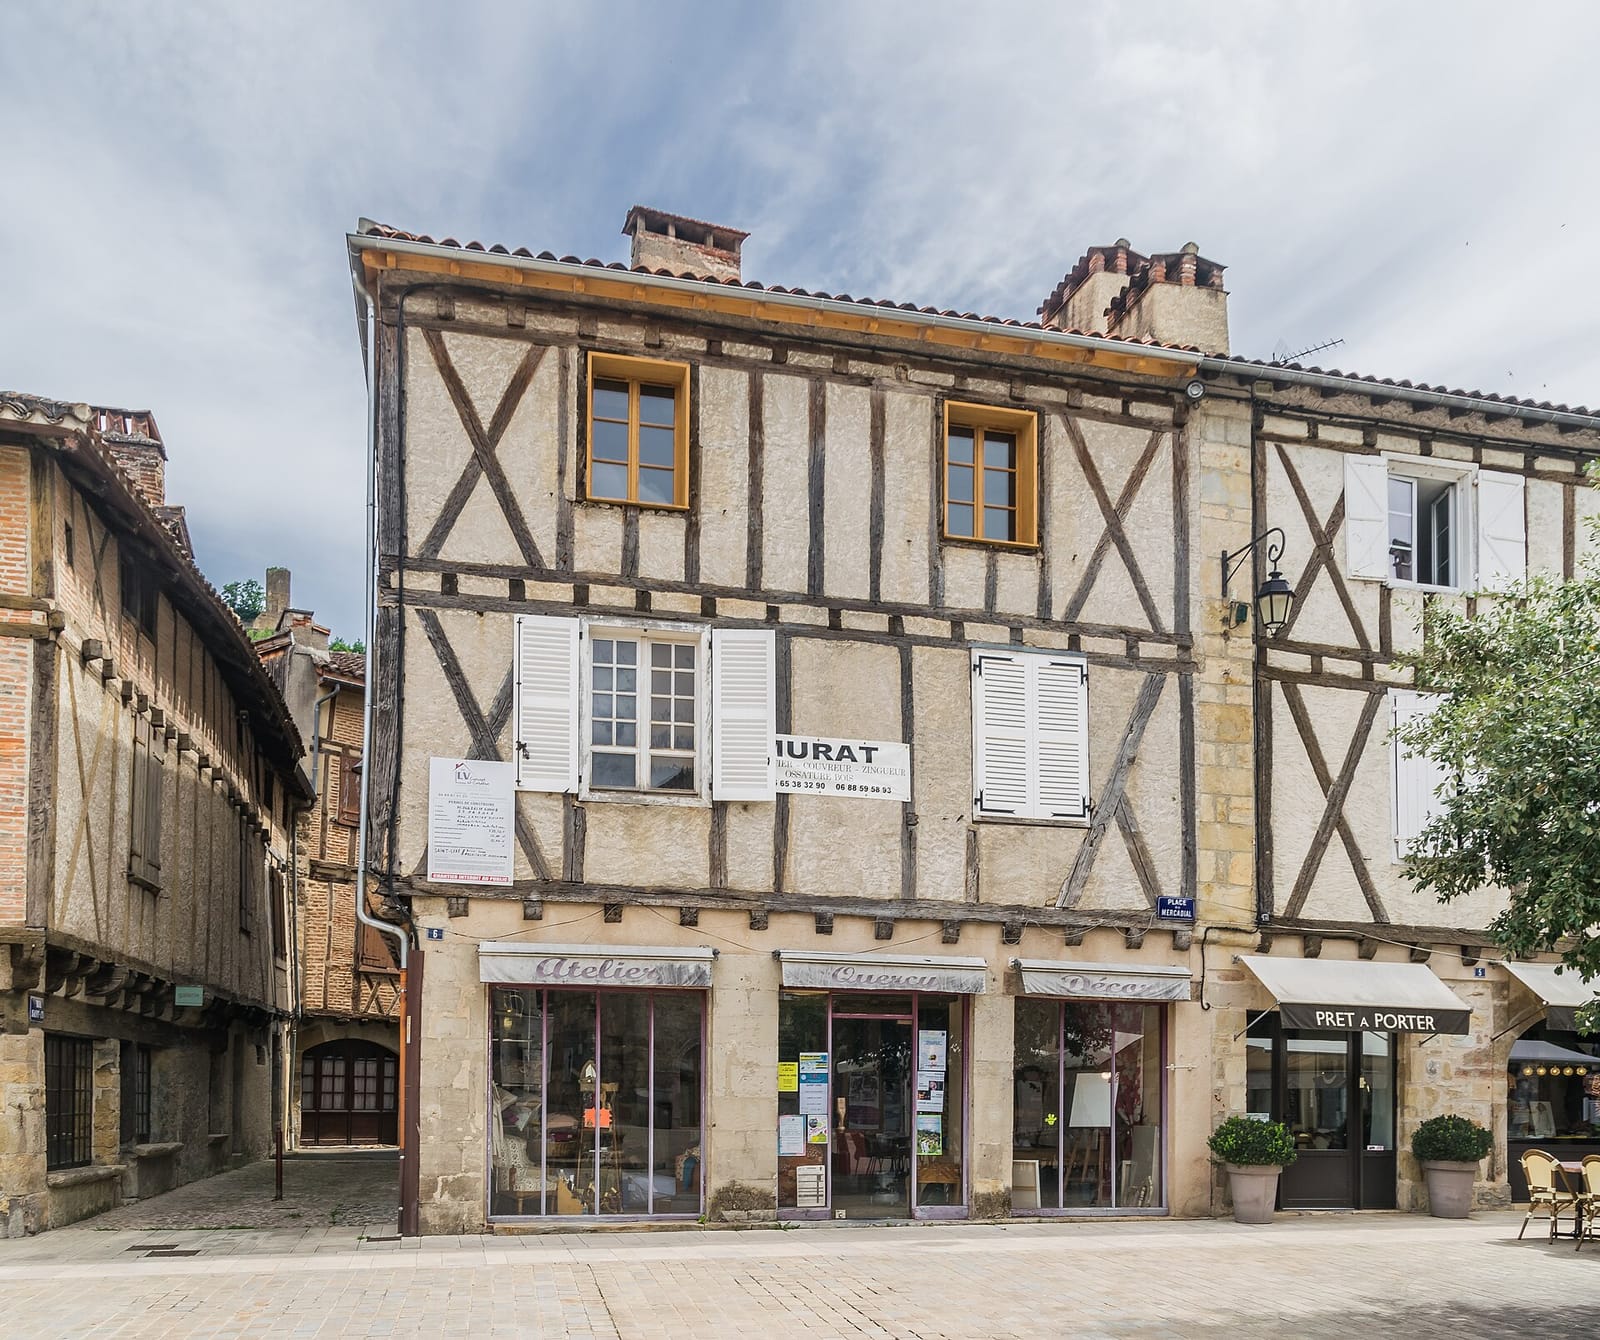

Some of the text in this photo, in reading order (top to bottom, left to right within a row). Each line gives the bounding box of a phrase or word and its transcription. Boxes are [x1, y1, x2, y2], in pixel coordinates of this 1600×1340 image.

[803, 761, 852, 773] COUVREUR
[862, 766, 906, 777] ZINGUEUR
[785, 770, 854, 781] OSSATURE BOIS
[835, 783, 845, 791] 06
[1168, 898, 1187, 906] PLACE
[433, 929, 438, 938] 6
[536, 957, 657, 979] Atelier
[1315, 1011, 1436, 1031] PRET A PORTER
